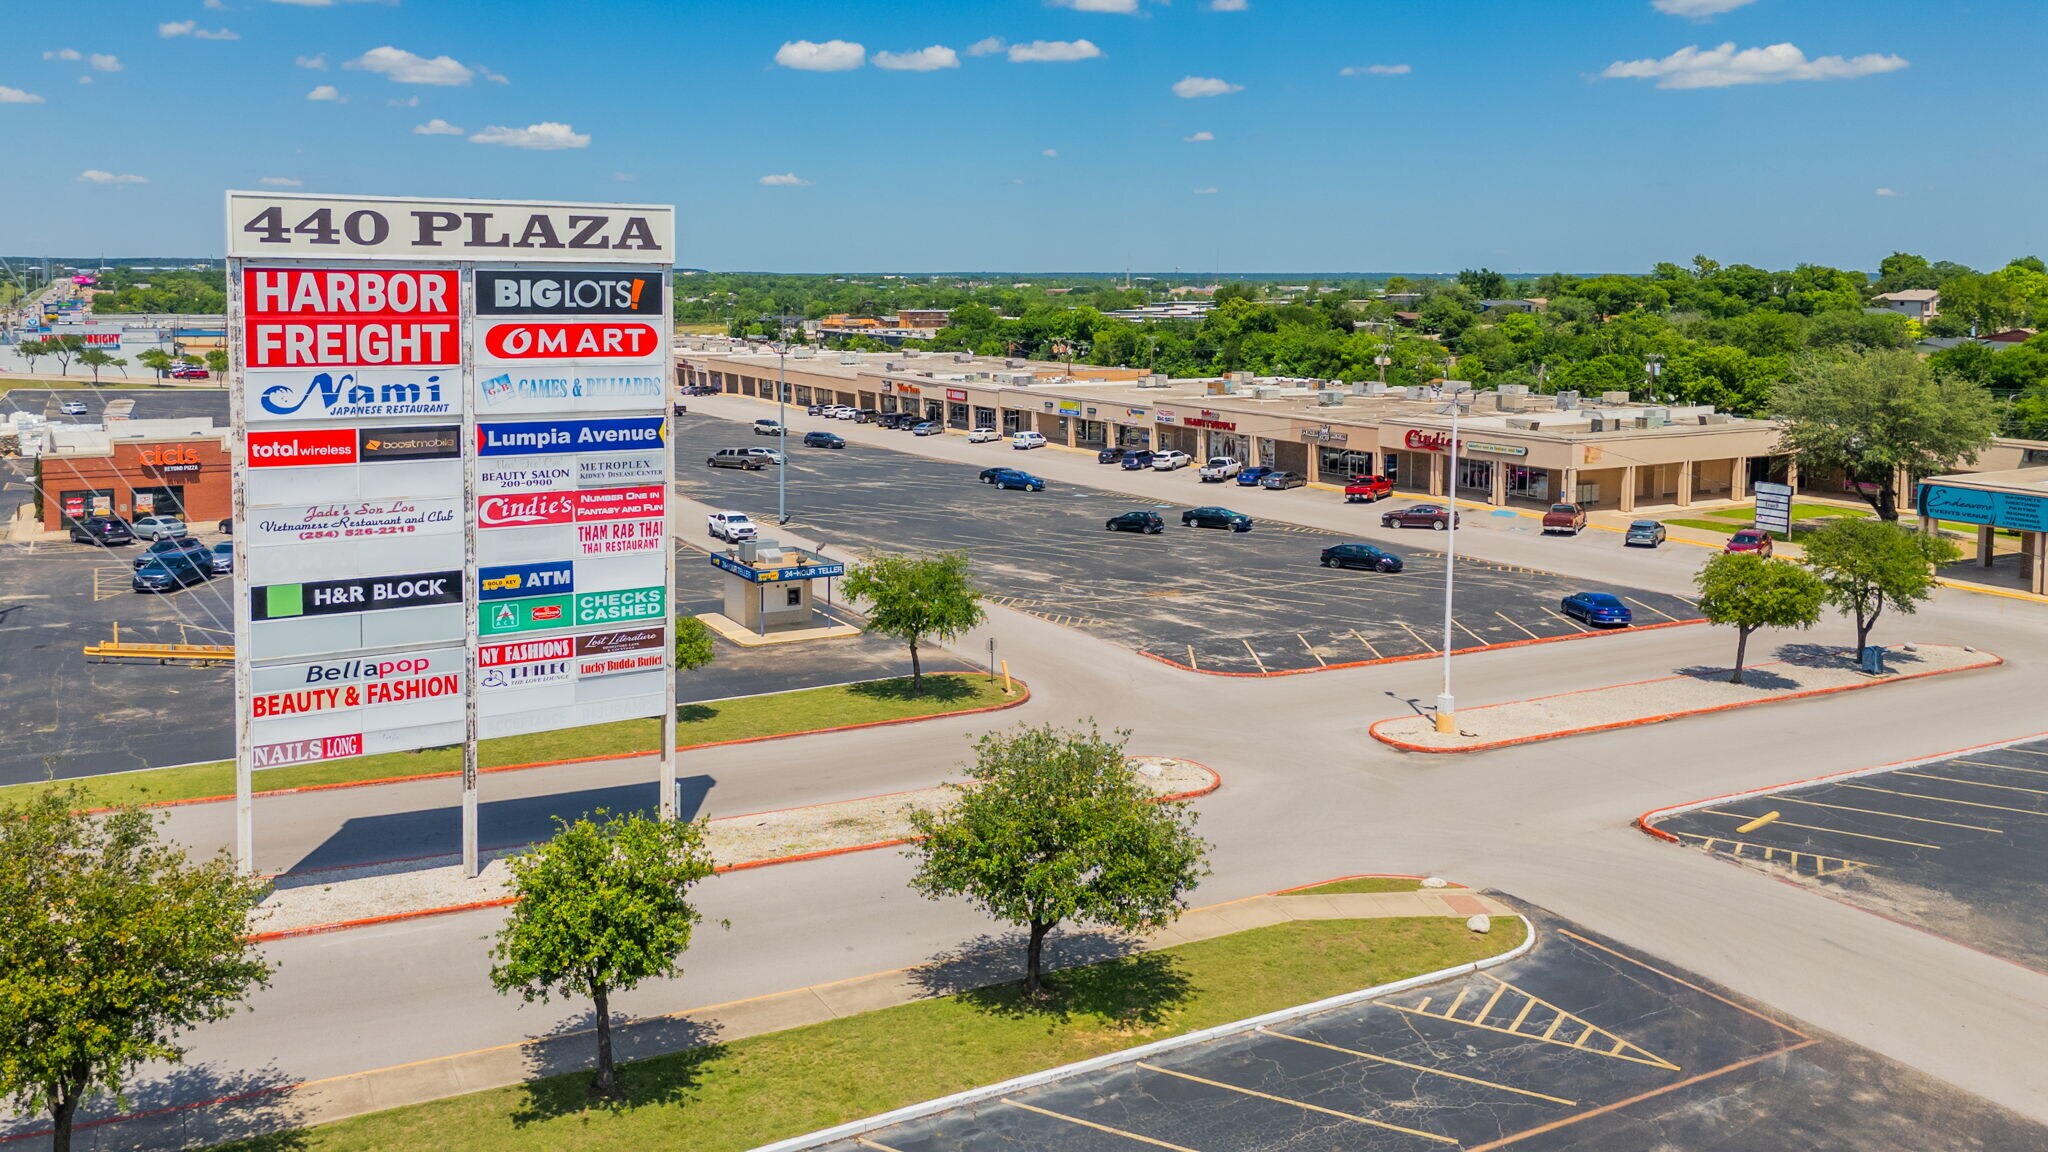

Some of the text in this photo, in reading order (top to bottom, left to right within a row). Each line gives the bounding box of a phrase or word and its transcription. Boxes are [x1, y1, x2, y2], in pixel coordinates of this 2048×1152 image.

[244, 206, 662, 250] 440 PLAZA
[256, 271, 448, 313] HARBOR
[256, 323, 450, 364] FREIGHT
[261, 372, 440, 415] Nami
[518, 378, 567, 399] GAMES
[572, 378, 582, 397] &
[330, 403, 450, 416] JAPANESE RESTAURANT
[488, 427, 657, 448] Lumpia Avenue
[252, 440, 352, 457] total wireless
[580, 460, 650, 471] METROPLEX
[580, 471, 606, 480] KIDNEY
[636, 468, 663, 477] CENTER
[482, 469, 570, 482] BEAUTY SALON
[501, 479, 552, 488] 200-0900
[581, 494, 623, 503] NUMBER
[626, 492, 647, 501] ONE
[304, 504, 350, 522] Jade's
[355, 502, 384, 515] Son
[479, 495, 572, 525] Cindie's
[577, 507, 619, 516] FANTASY
[643, 503, 664, 512] FUN
[1929, 508, 1960, 516] EVENTS
[260, 510, 454, 532] Vietnamese Restaurant and Club
[299, 531, 339, 540] (254)
[578, 521, 663, 542] THAM RAB THAI
[583, 538, 659, 554] THAI RESTAURANT
[526, 570, 571, 588] ATM
[784, 566, 843, 578] 24-HOUR TELLER
[314, 580, 445, 606] H&R BLOCK
[580, 590, 661, 608] CHECKS
[580, 604, 661, 621] CASHED
[585, 635, 608, 648] Lost
[481, 640, 569, 665] NY FASHIONS
[306, 657, 430, 683] Bellapop
[581, 662, 605, 674] Lucky
[607, 659, 635, 671] Budda
[253, 674, 458, 718] BEAUTY & FASHION
[253, 739, 323, 767] NAILS
[326, 735, 358, 757] LONG
